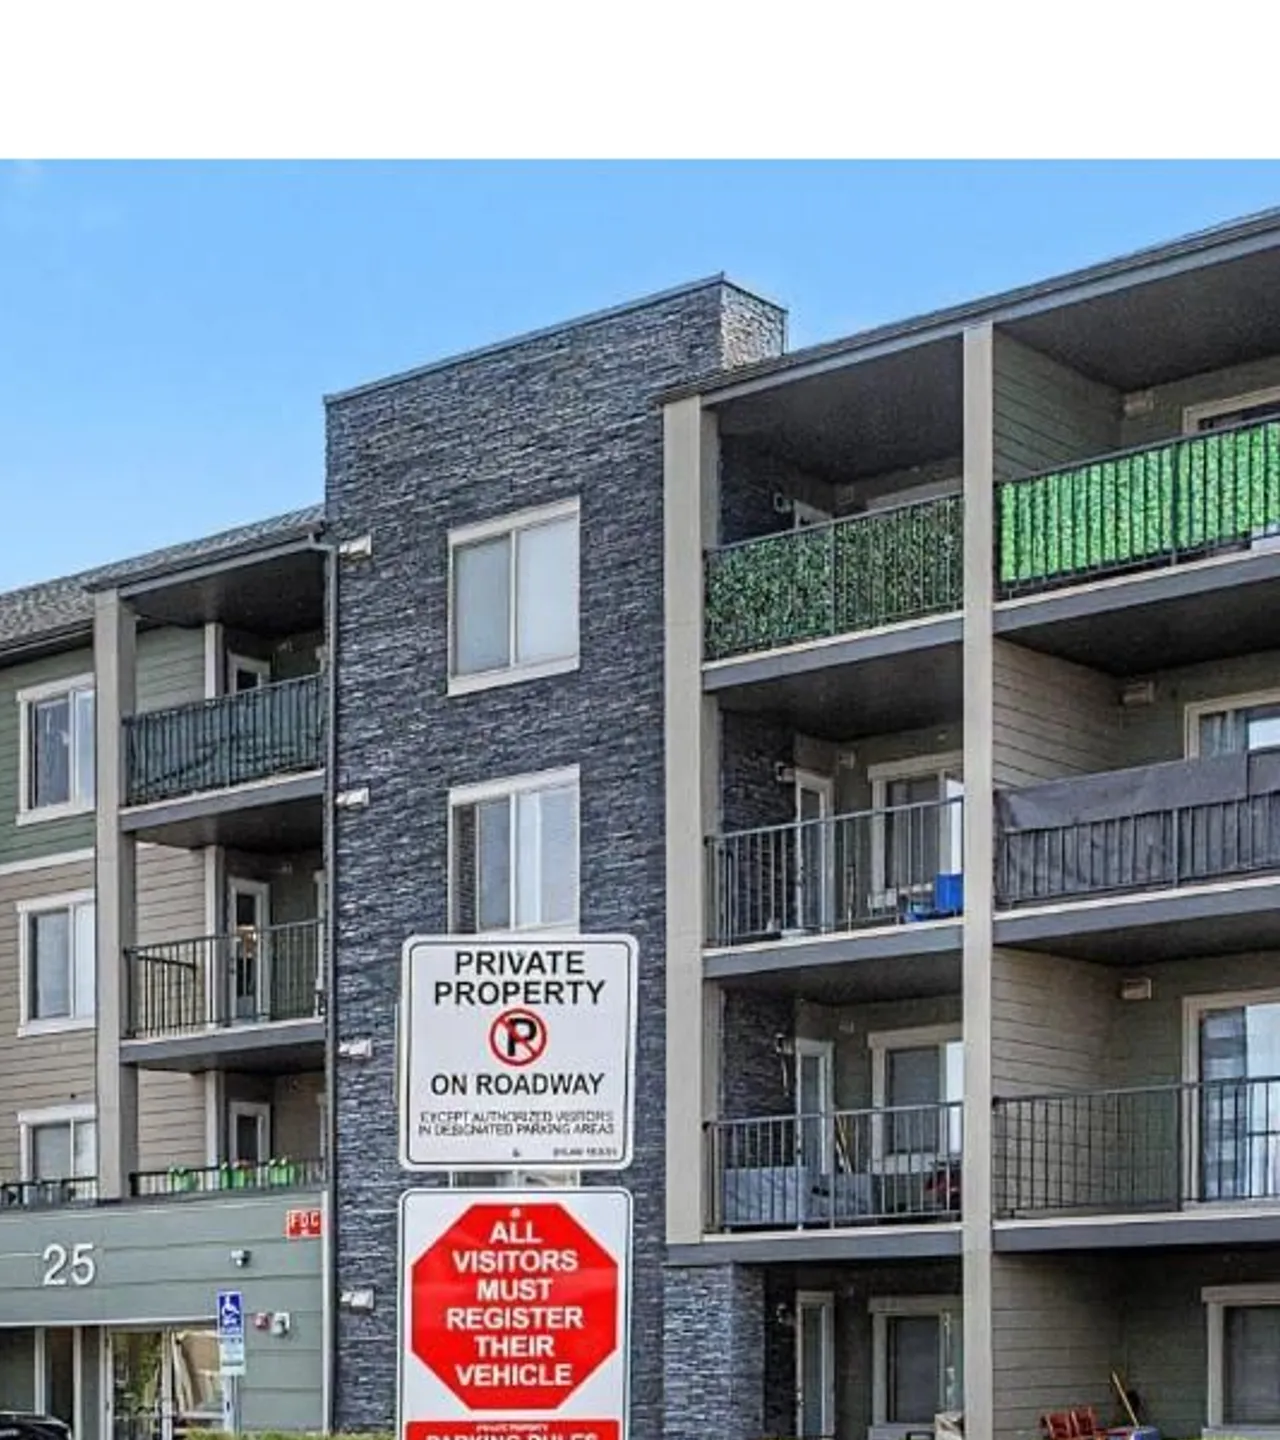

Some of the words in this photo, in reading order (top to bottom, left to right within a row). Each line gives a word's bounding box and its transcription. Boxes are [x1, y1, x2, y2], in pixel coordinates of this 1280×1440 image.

[455, 951, 585, 975] PRIVATE
[434, 980, 605, 1005] PROPERTY
[431, 1074, 467, 1095] ON
[476, 1073, 605, 1095] ROADWAY
[490, 1221, 543, 1244] ALL
[41, 1243, 97, 1286] 25
[452, 1251, 579, 1273] VISITORS
[476, 1279, 553, 1301] MUST
[447, 1307, 583, 1329] REGISTER
[474, 1335, 555, 1357] THEIR
[455, 1364, 573, 1386] VEHICLE
